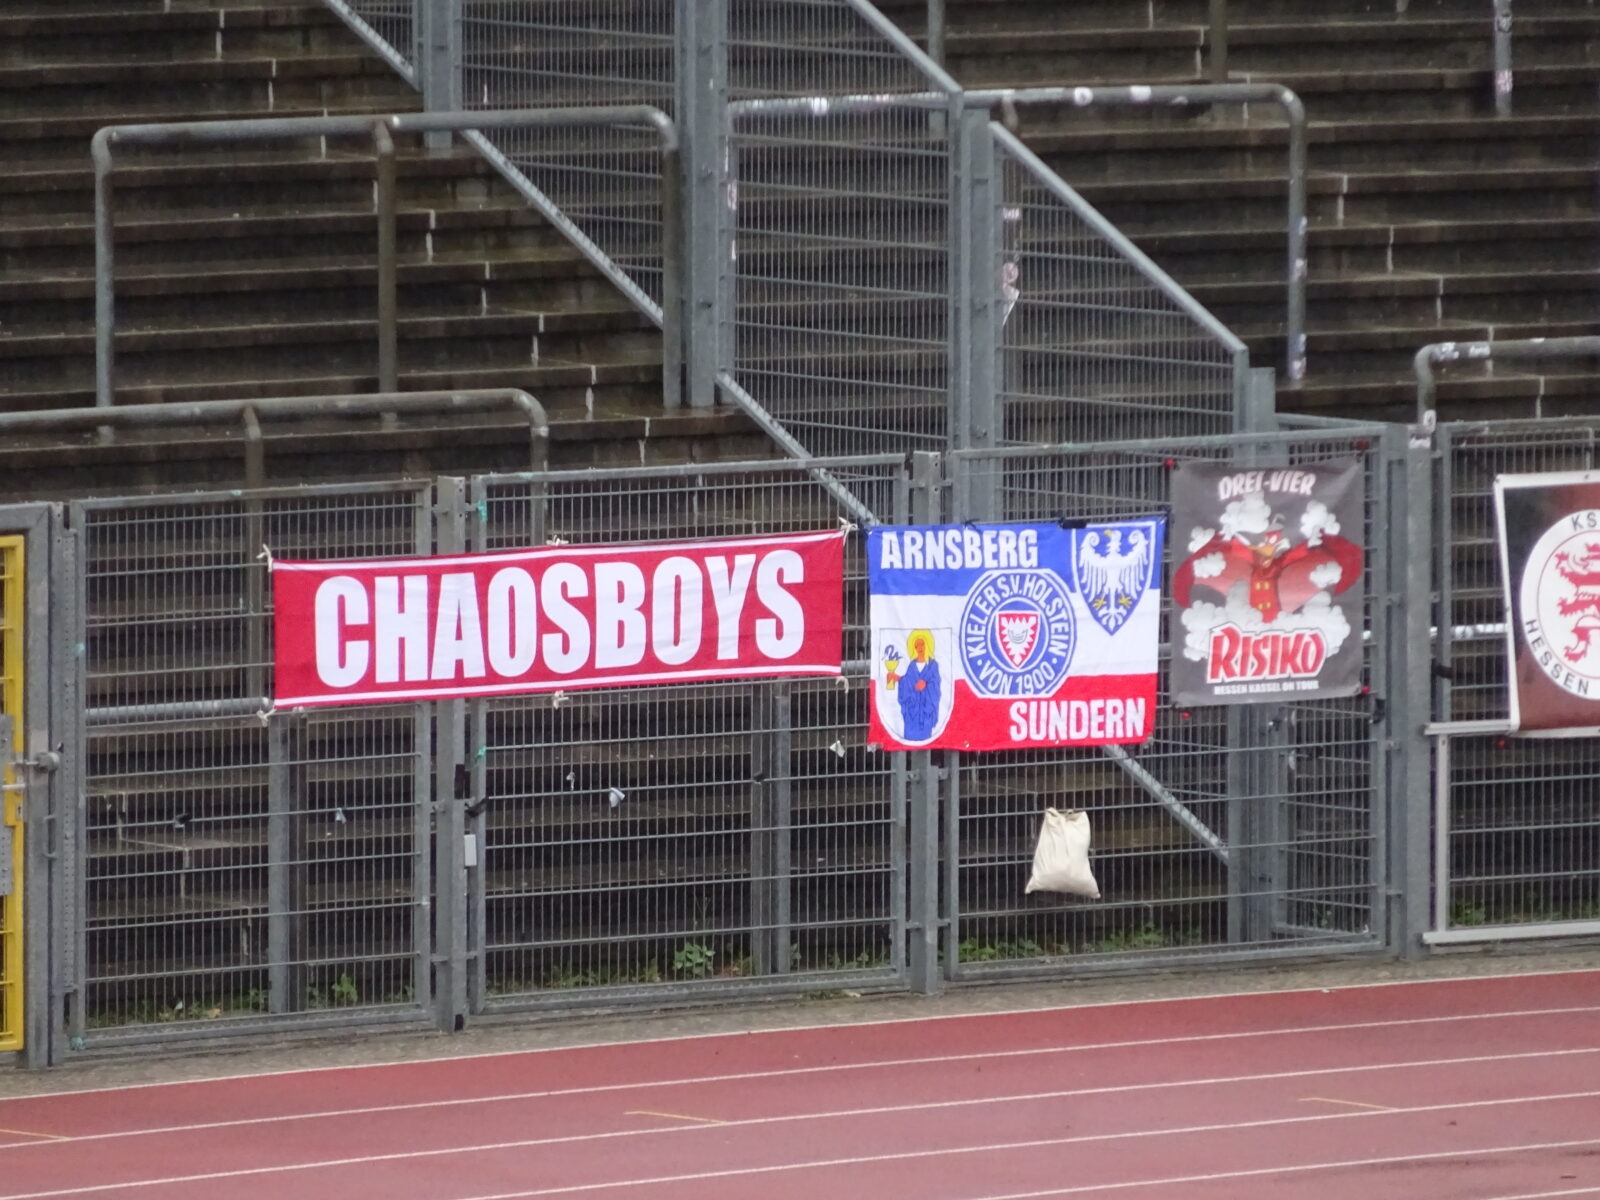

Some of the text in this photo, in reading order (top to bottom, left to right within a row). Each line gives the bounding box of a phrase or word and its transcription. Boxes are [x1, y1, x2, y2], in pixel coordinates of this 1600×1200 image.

[1218, 470, 1317, 500] DREI-VIER
[881, 528, 1038, 569] ARNSBERG
[314, 549, 805, 688] CHAOSBOYS
[966, 585, 1001, 658] KIELER
[1022, 574, 1070, 657] HOLSTEIN
[979, 659, 1056, 695] VON 1900
[1208, 624, 1326, 681] RISIKO
[1525, 618, 1590, 696] HESSEN
[1009, 697, 1146, 742] SUNDERN
